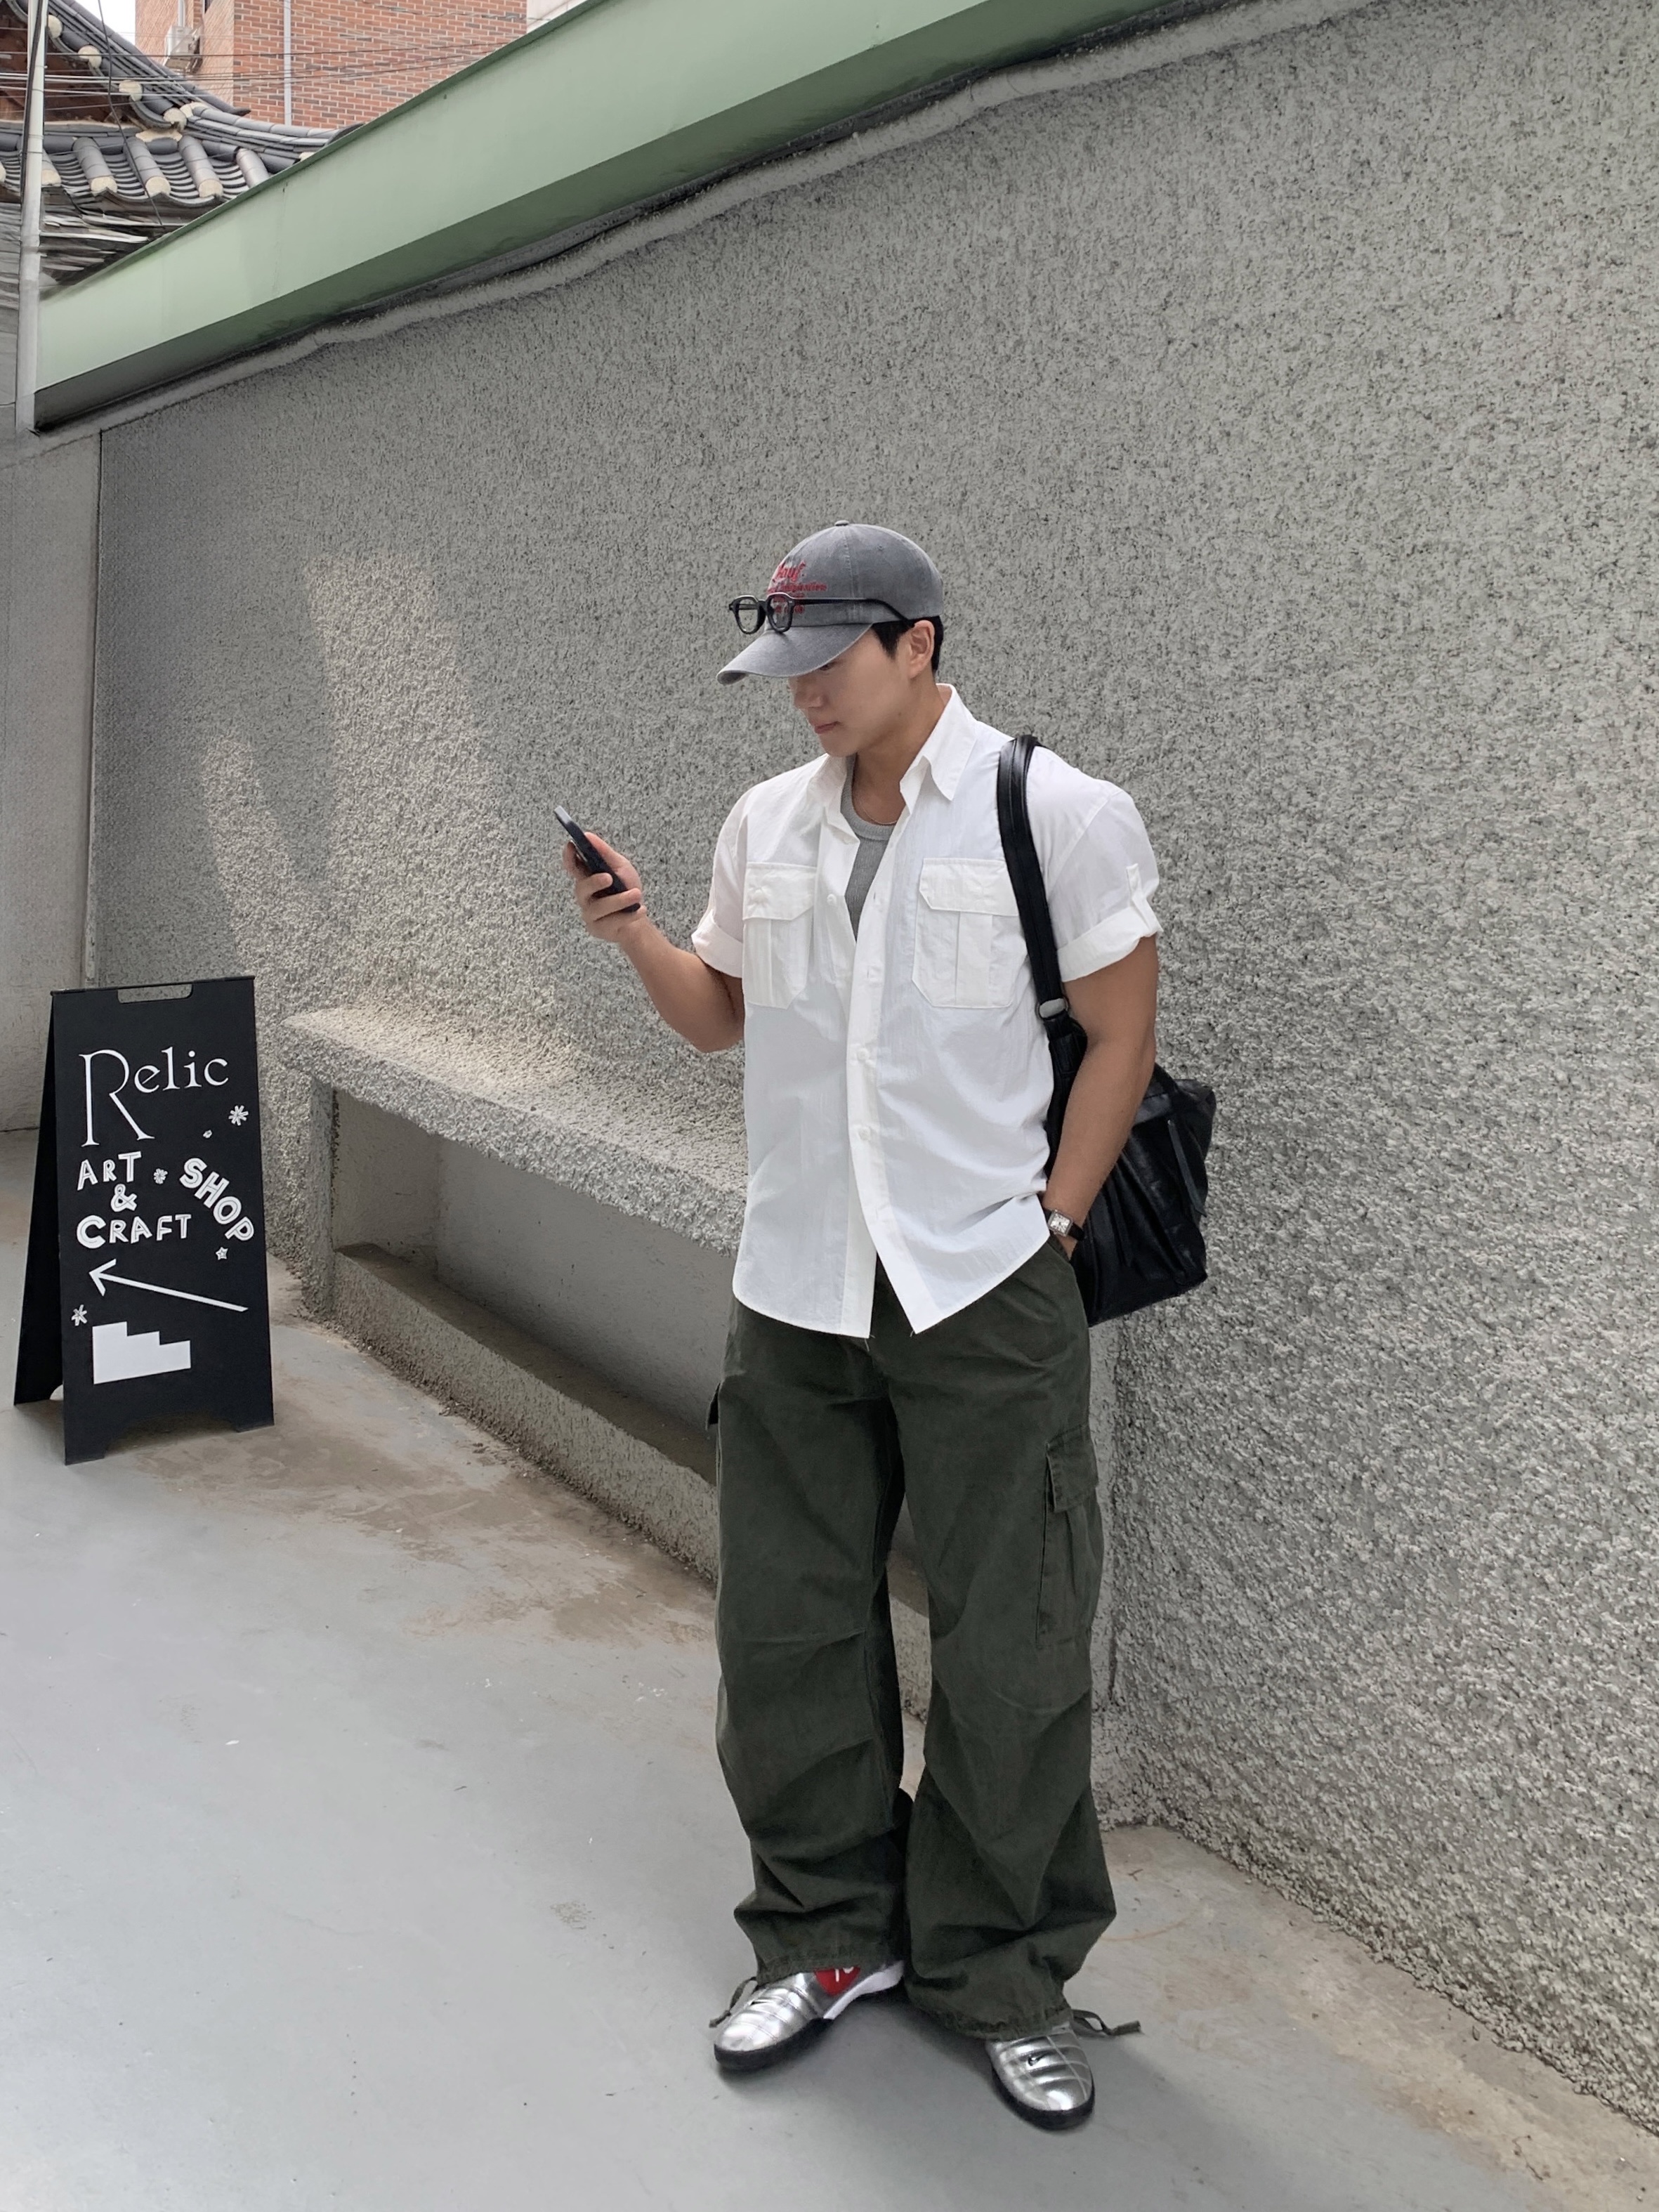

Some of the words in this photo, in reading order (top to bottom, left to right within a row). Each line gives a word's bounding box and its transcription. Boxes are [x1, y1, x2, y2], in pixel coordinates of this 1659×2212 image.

[79, 1046, 229, 1147] Relic
[77, 1151, 142, 1191] ART
[110, 1183, 138, 1212] &
[179, 1158, 254, 1241] SHOP
[76, 1214, 192, 1249] CRAFT
